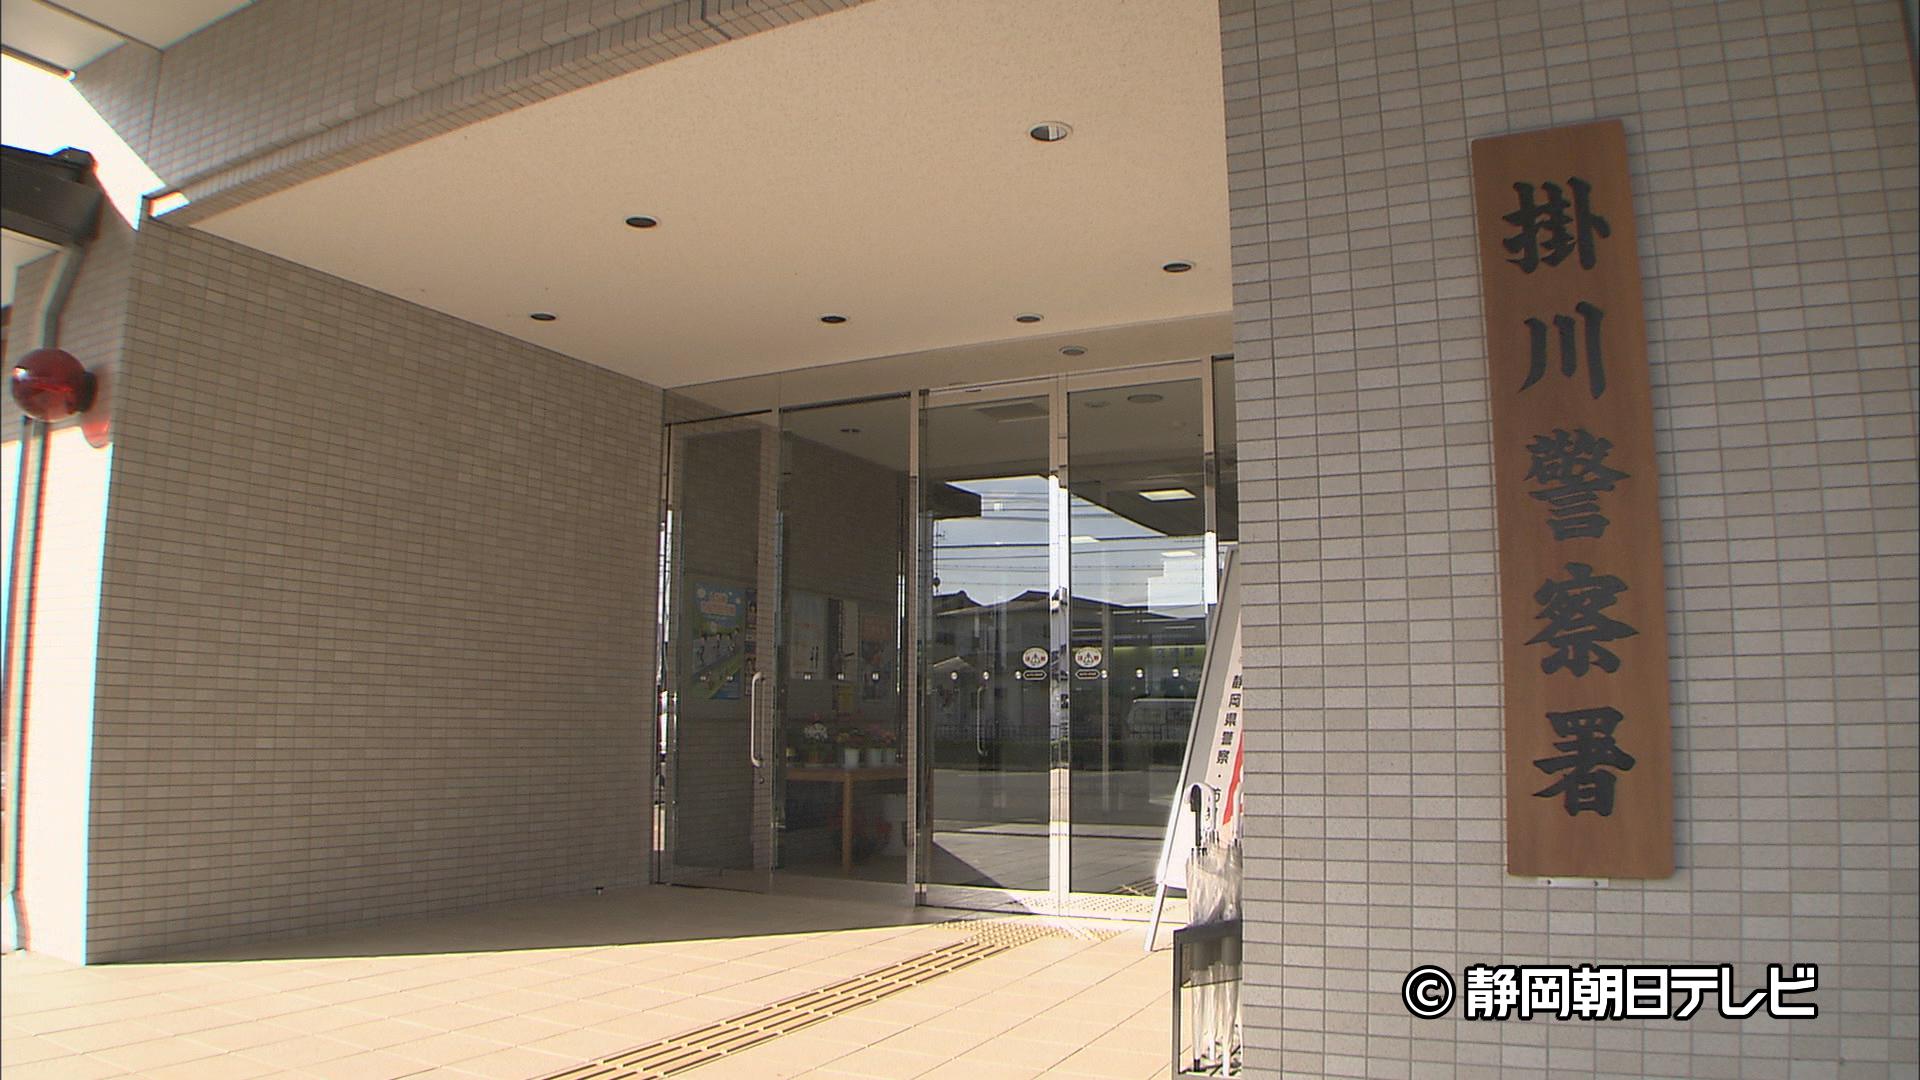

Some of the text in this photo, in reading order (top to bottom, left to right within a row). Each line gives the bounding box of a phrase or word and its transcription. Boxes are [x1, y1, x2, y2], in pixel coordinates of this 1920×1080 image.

[1502, 176, 1638, 817] 掛川警察署
